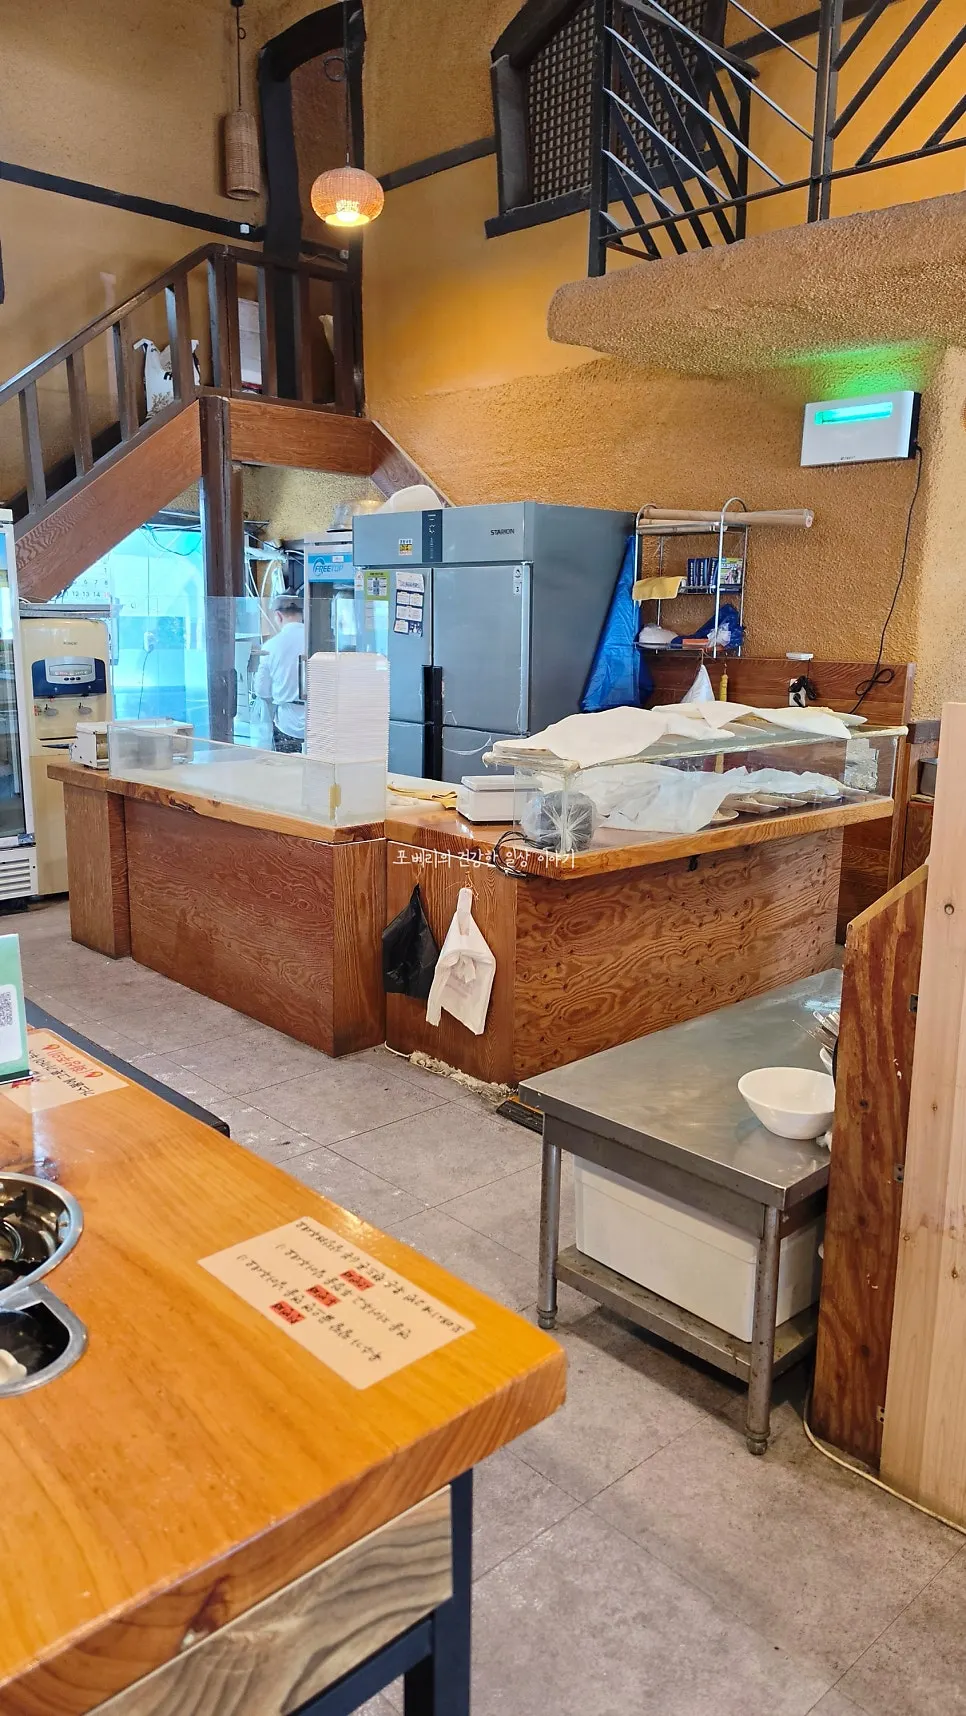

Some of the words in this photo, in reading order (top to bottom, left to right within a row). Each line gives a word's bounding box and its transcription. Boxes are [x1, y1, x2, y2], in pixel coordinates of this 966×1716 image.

[490, 528, 515, 536] STARION
[355, 1262, 385, 1281] 핸드폰
[323, 1277, 352, 1296] 뚜껑을
[283, 1288, 304, 1304] 면을
[300, 1302, 334, 1323] 끓으면
[328, 1322, 352, 1339] 팔팔
[388, 1322, 411, 1339] 면을
